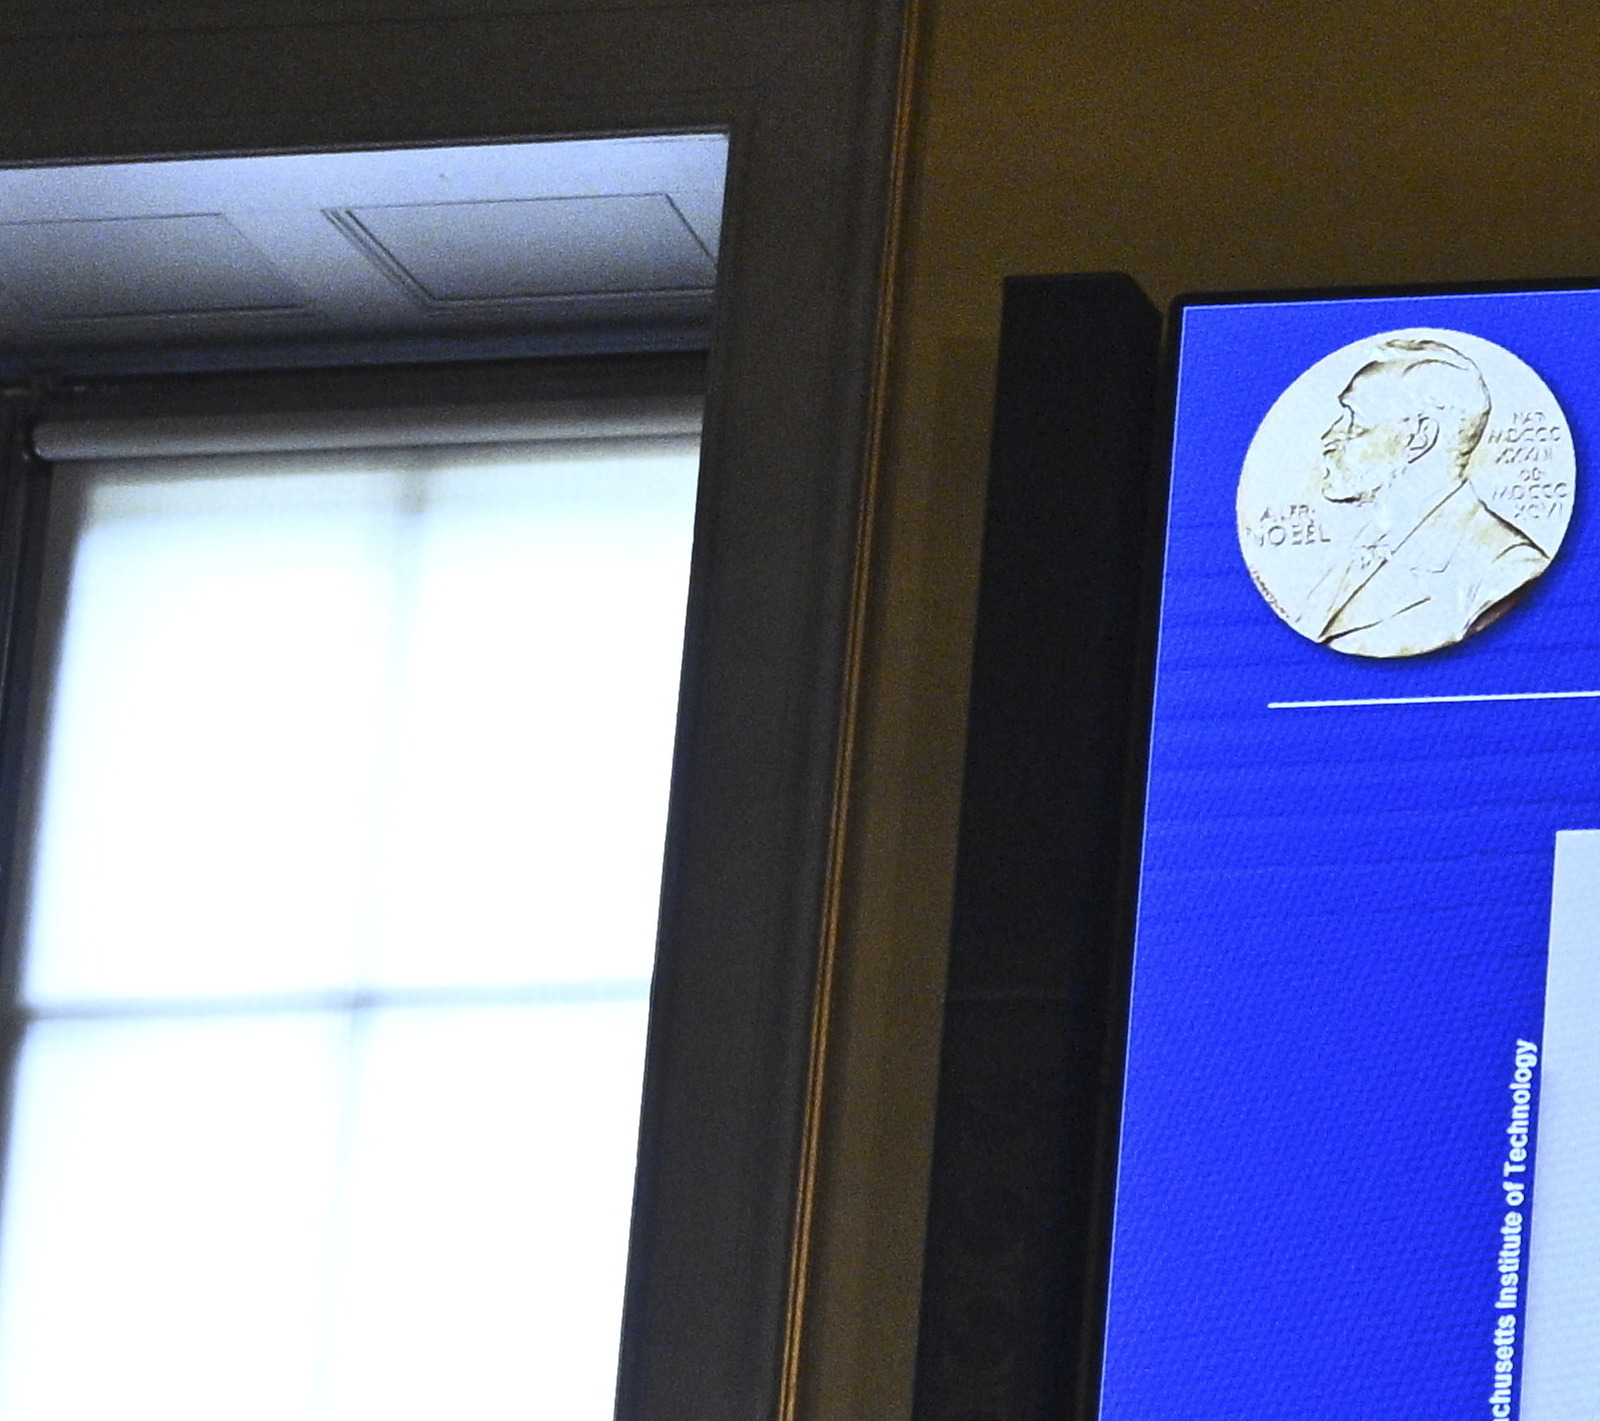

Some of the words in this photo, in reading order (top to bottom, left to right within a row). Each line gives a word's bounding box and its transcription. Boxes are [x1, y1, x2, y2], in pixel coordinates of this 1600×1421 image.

[1504, 1040, 1537, 1176] Technology
[1503, 1182, 1524, 1205] of
[1495, 1212, 1522, 1308] Institute
